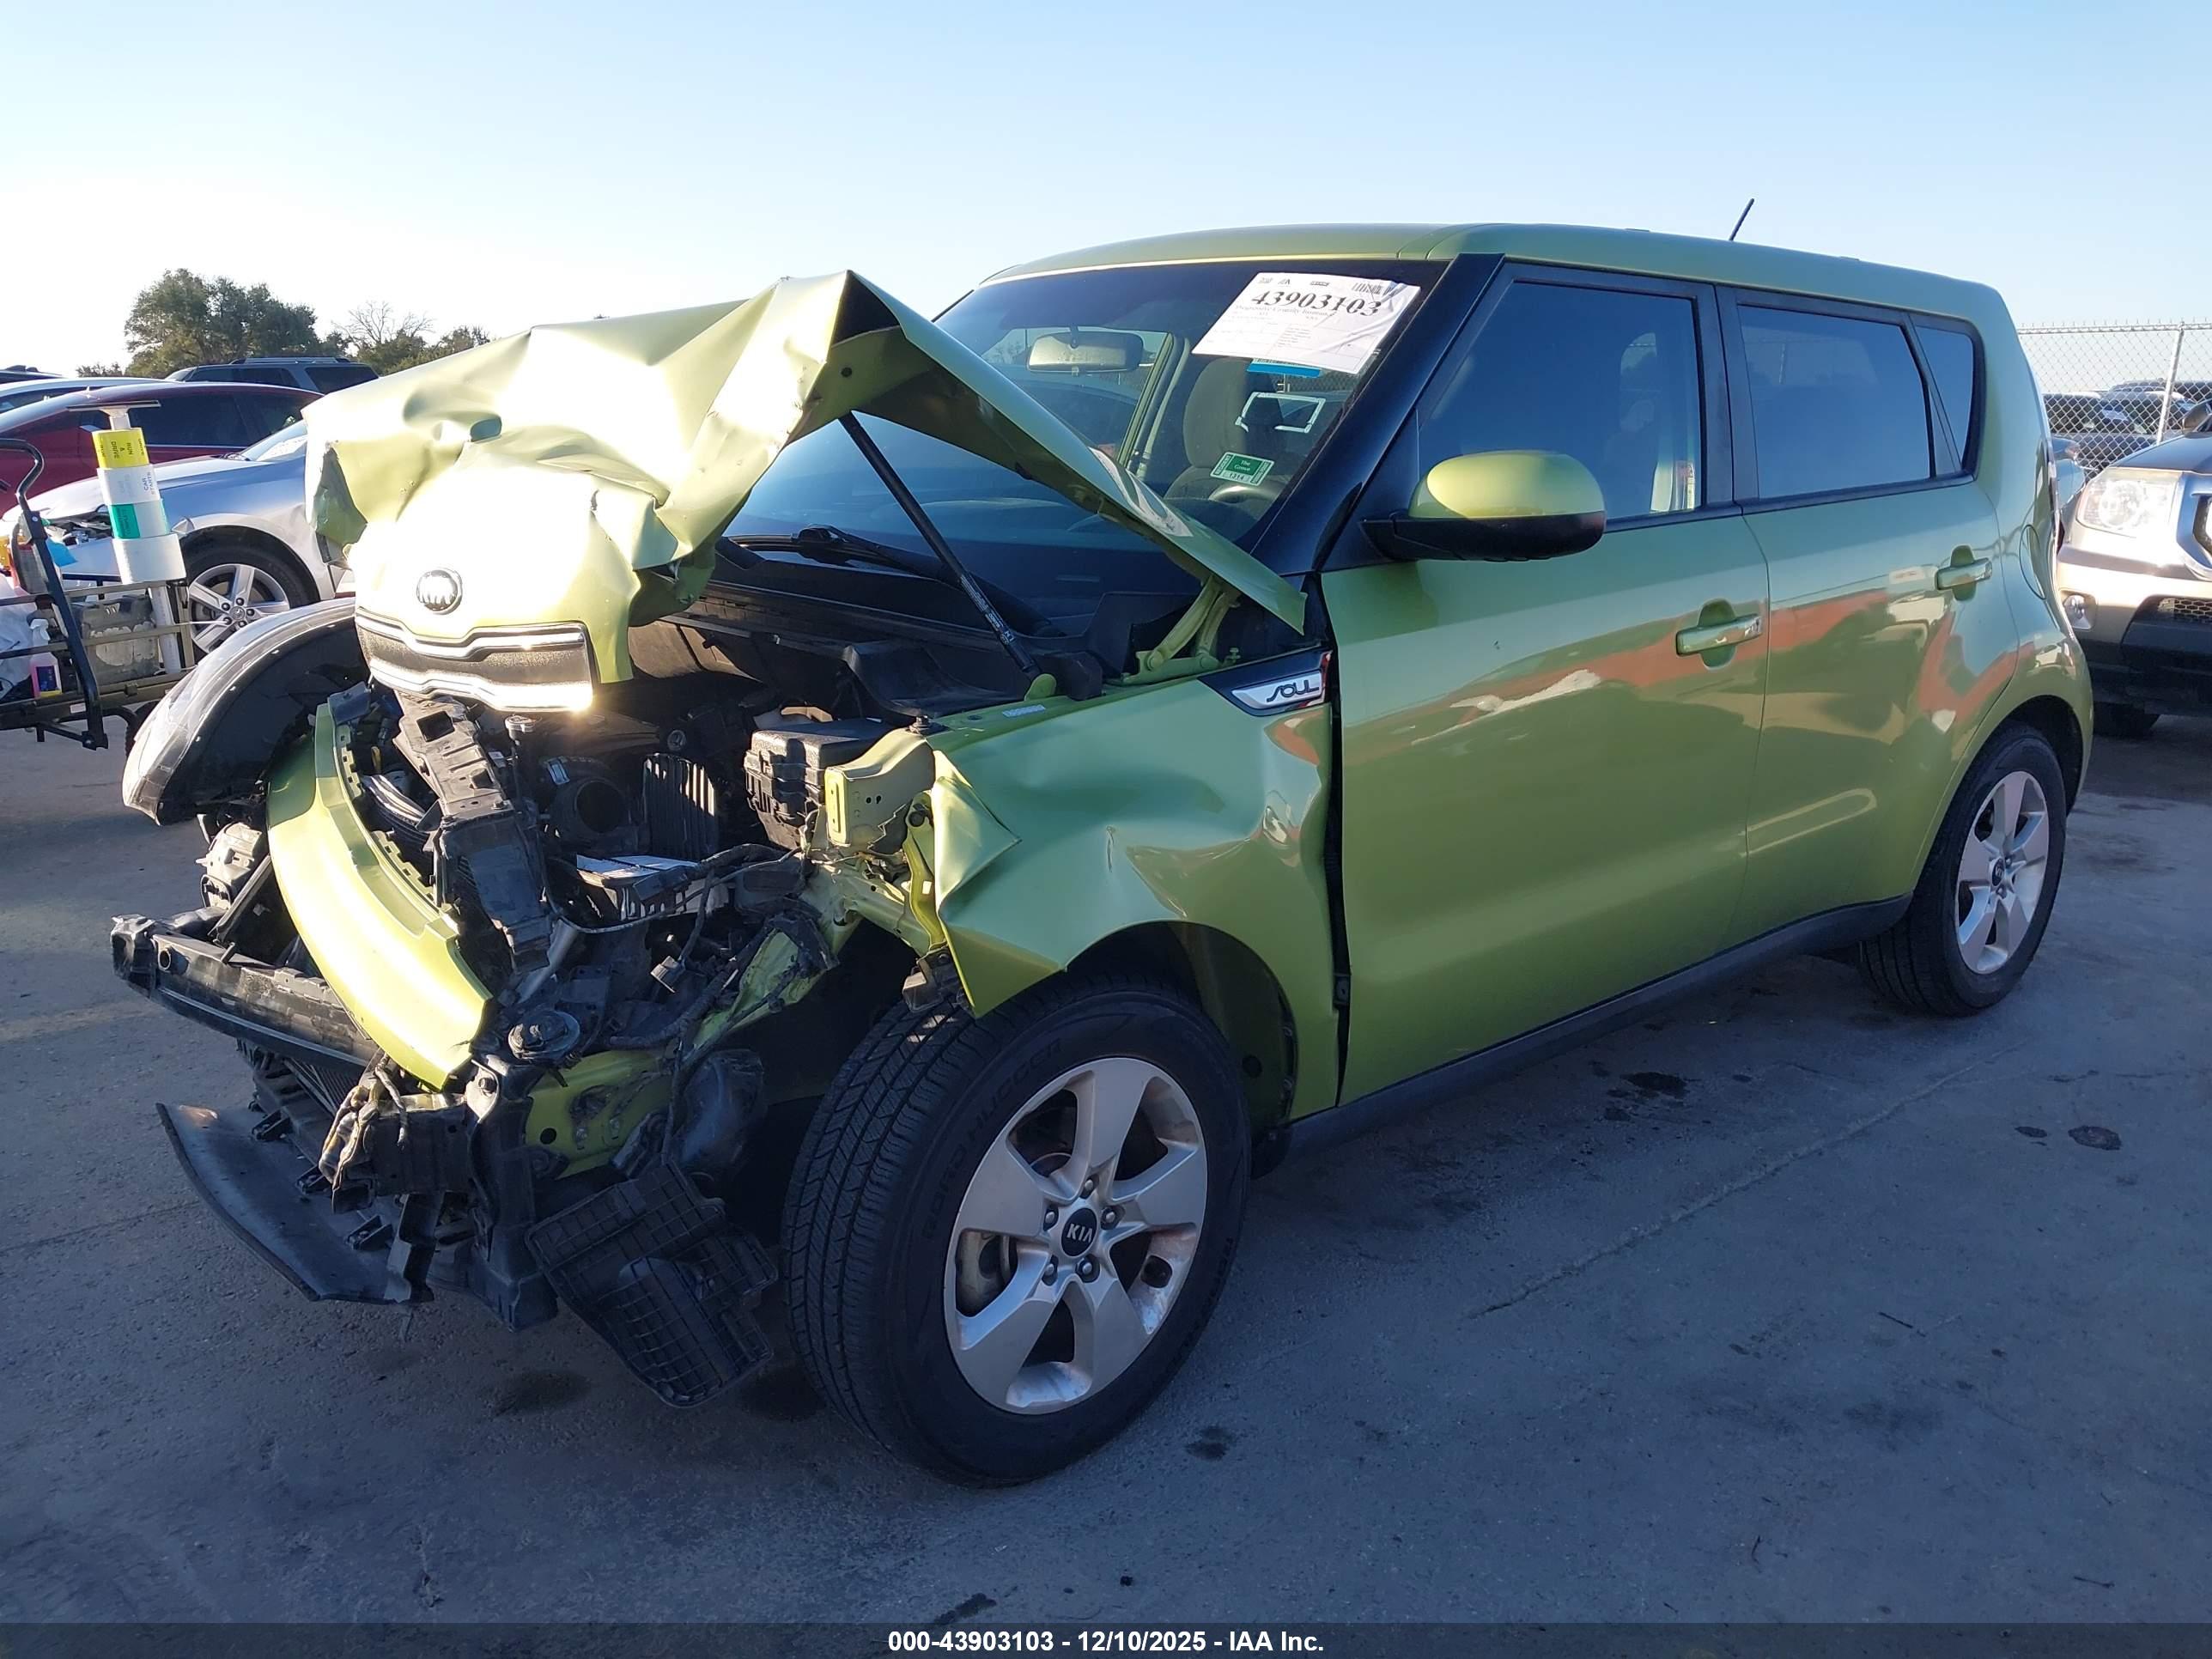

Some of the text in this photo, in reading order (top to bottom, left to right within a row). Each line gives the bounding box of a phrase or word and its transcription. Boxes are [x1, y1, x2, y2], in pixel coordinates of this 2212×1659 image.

[1252, 290, 1382, 317] 43903103
[1267, 680, 1320, 702] SOUL
[1066, 1223, 1093, 1243] KIA
